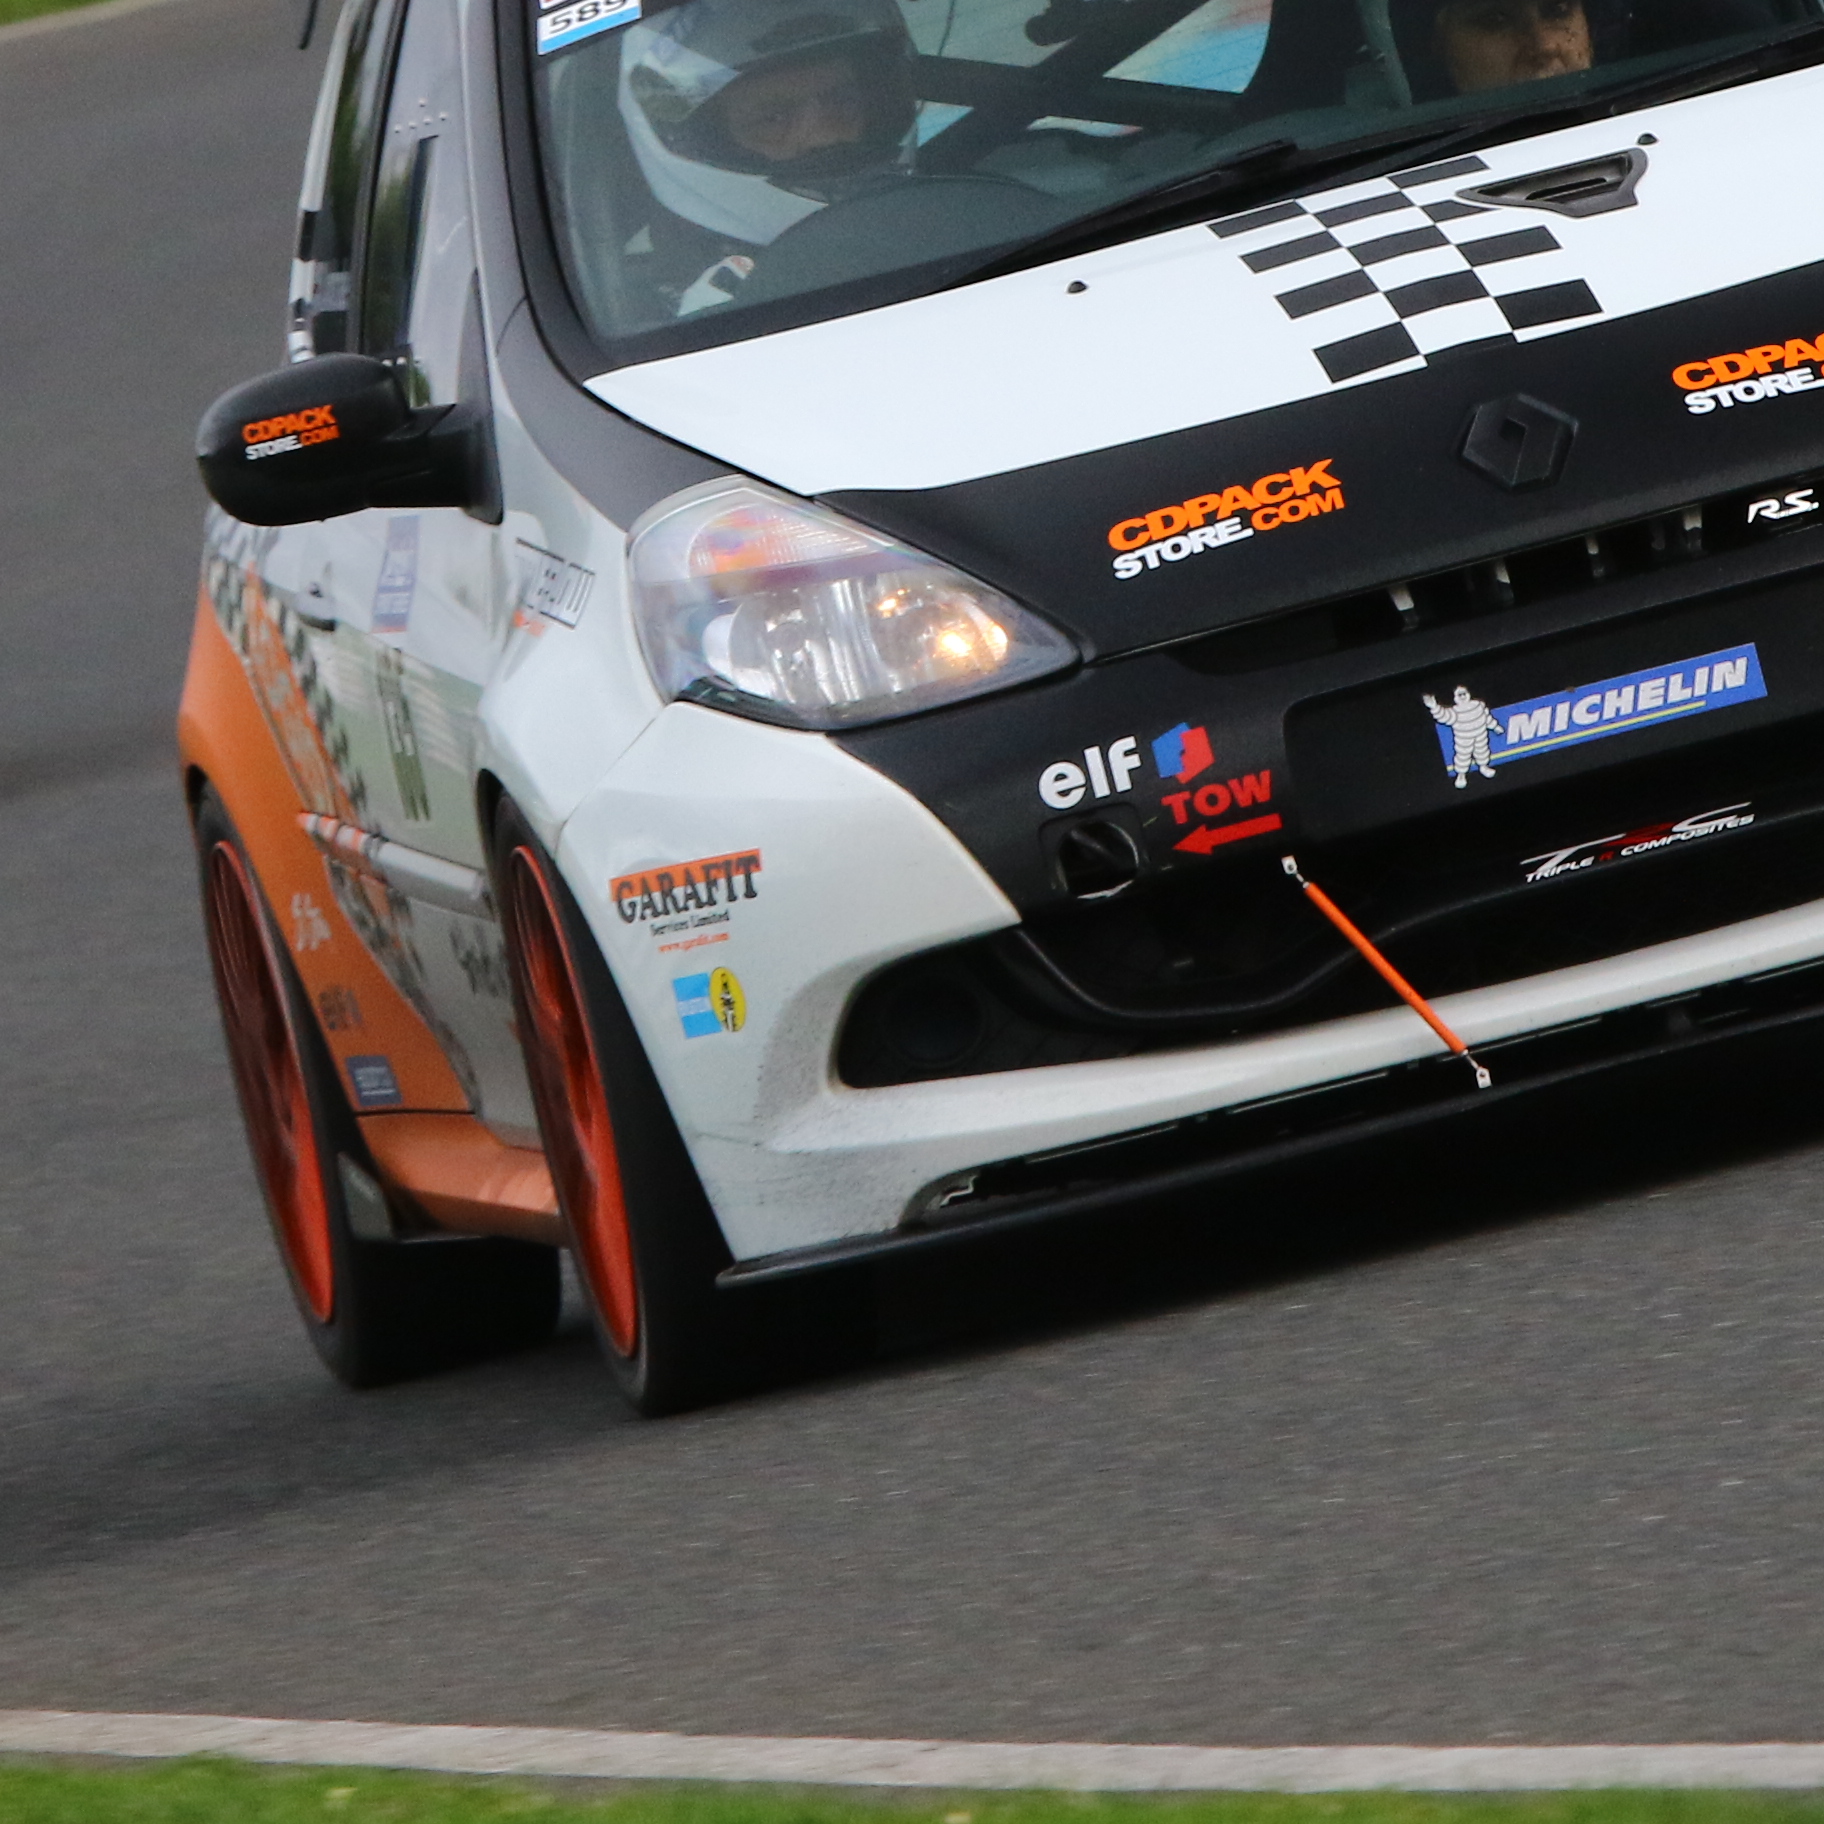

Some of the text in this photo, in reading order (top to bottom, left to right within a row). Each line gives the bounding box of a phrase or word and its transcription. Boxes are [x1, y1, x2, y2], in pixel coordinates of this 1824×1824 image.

[242, 404, 337, 444] CDPACK
[1108, 458, 1342, 551] CDPACK
[1506, 656, 1748, 745] MICHELIN
[1038, 735, 1142, 809] elf
[1161, 770, 1272, 824] TOW
[1526, 856, 1594, 883] TRIPLE
[1620, 814, 1755, 857] COMPOSITES
[617, 854, 760, 924] GARAFIT
